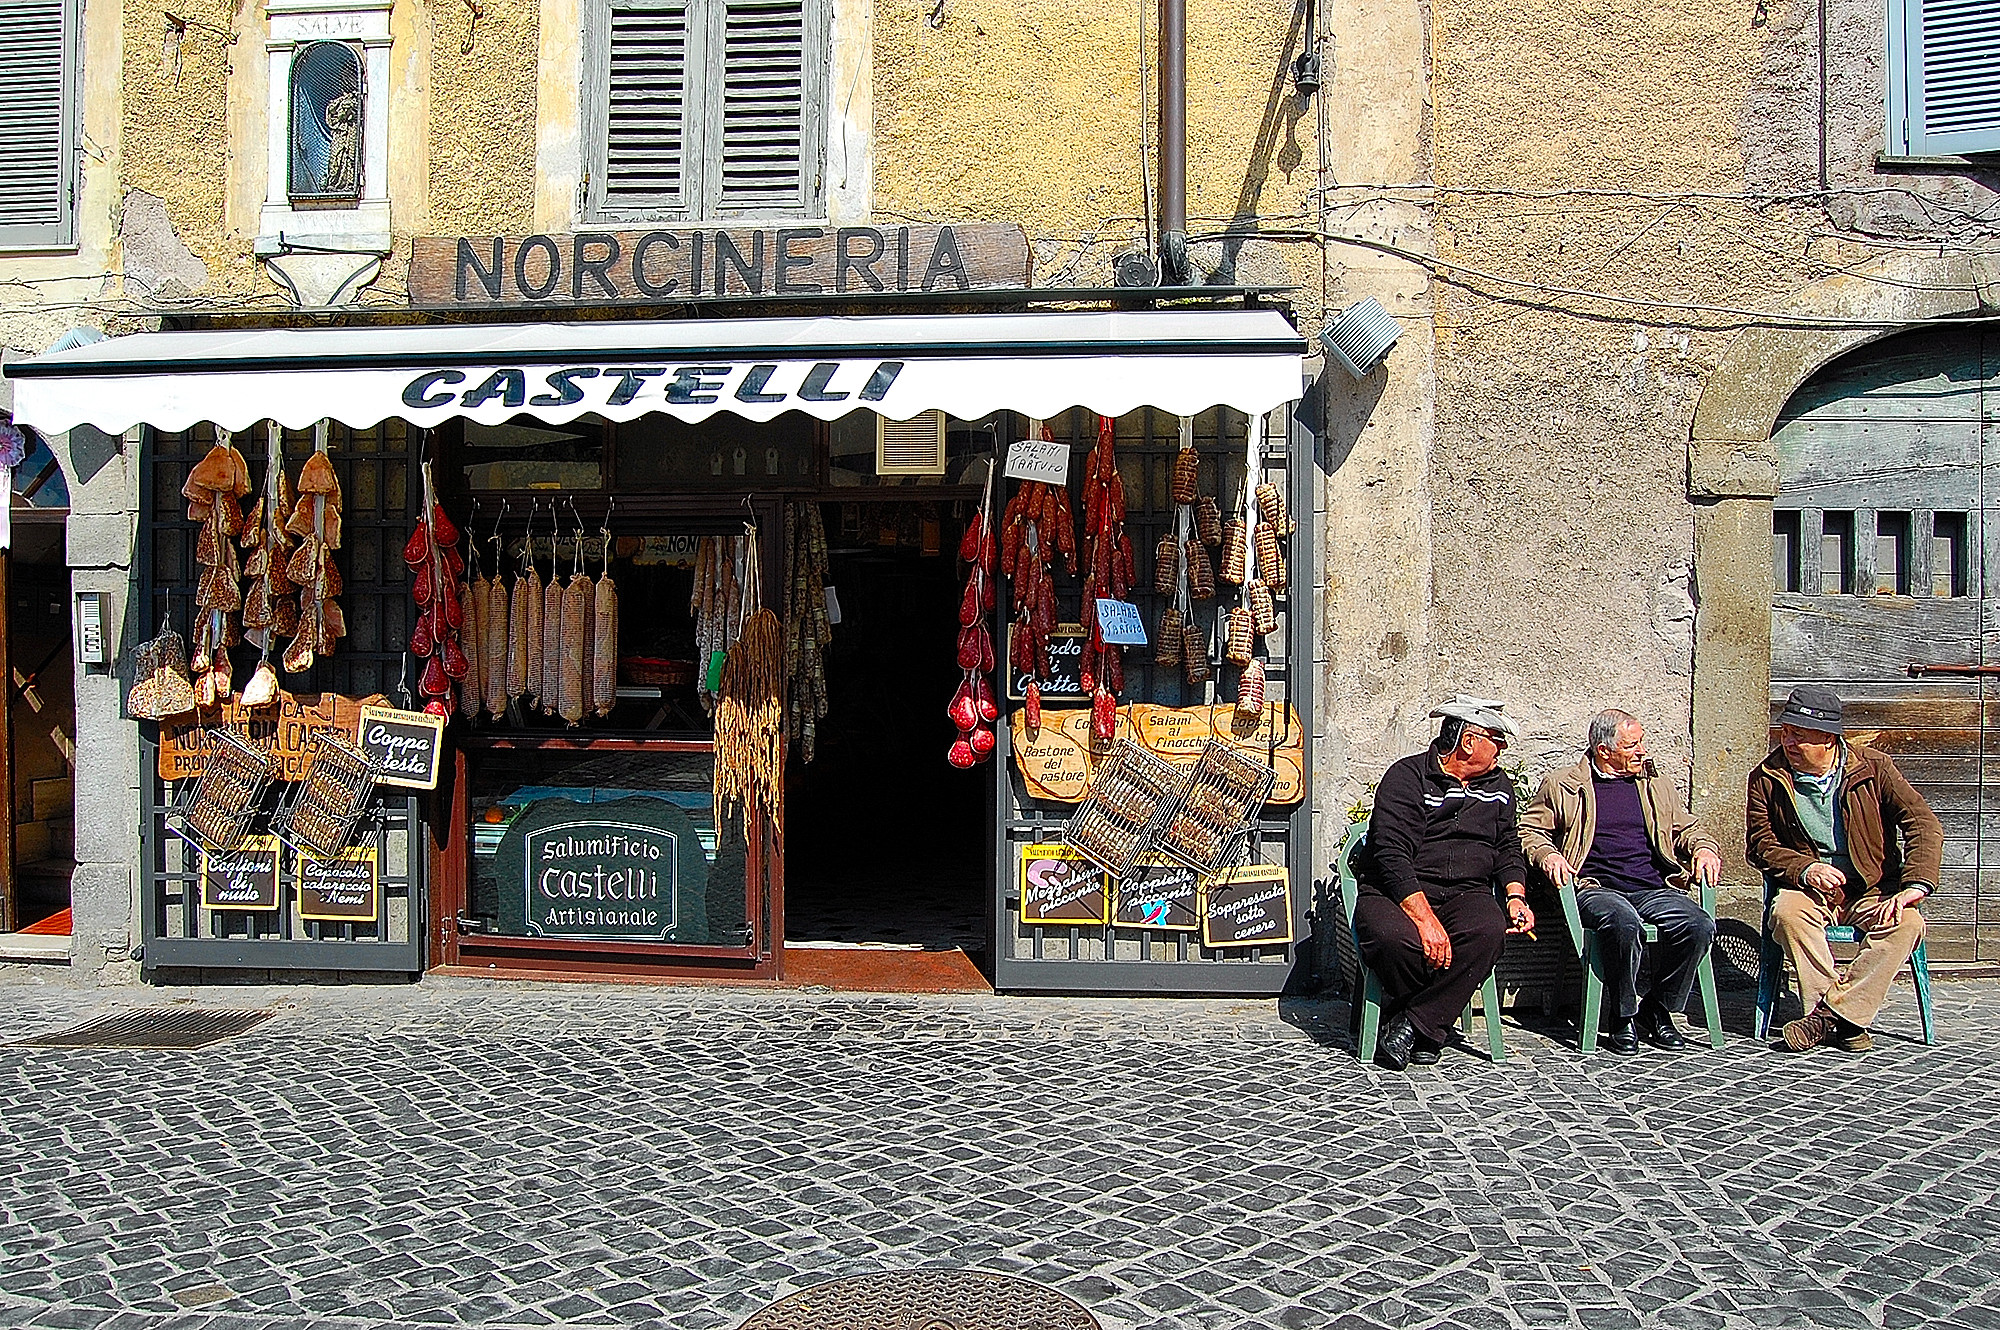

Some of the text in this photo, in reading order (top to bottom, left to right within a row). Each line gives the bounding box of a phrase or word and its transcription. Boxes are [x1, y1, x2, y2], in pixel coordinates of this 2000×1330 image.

[297, 15, 364, 35] SALVE
[455, 225, 971, 301] NORCINERIA
[402, 362, 904, 408] CASTELLI
[1012, 441, 1061, 457] SALAMI
[1010, 455, 1064, 473] TARTUFO
[1101, 603, 1138, 618] SALAME
[1149, 715, 1192, 726] Salami
[1232, 717, 1272, 731] Coppa
[368, 724, 431, 756] Coppa
[1168, 726, 1181, 737] al
[1024, 745, 1075, 758] Bastone
[383, 753, 428, 774] testa
[1043, 758, 1063, 770] del
[1040, 772, 1085, 783] pastore
[542, 834, 661, 861] Salumificio
[230, 871, 248, 889] di
[305, 863, 371, 881] Capocollo
[217, 882, 260, 901] mulo
[302, 879, 372, 892] casareccio
[540, 864, 658, 901] Castelli
[326, 889, 366, 904] Nemi
[1207, 882, 1286, 919] Soppressata
[544, 907, 658, 926] Artigianale
[1235, 904, 1266, 925] sotto
[1234, 919, 1277, 940] cenere
